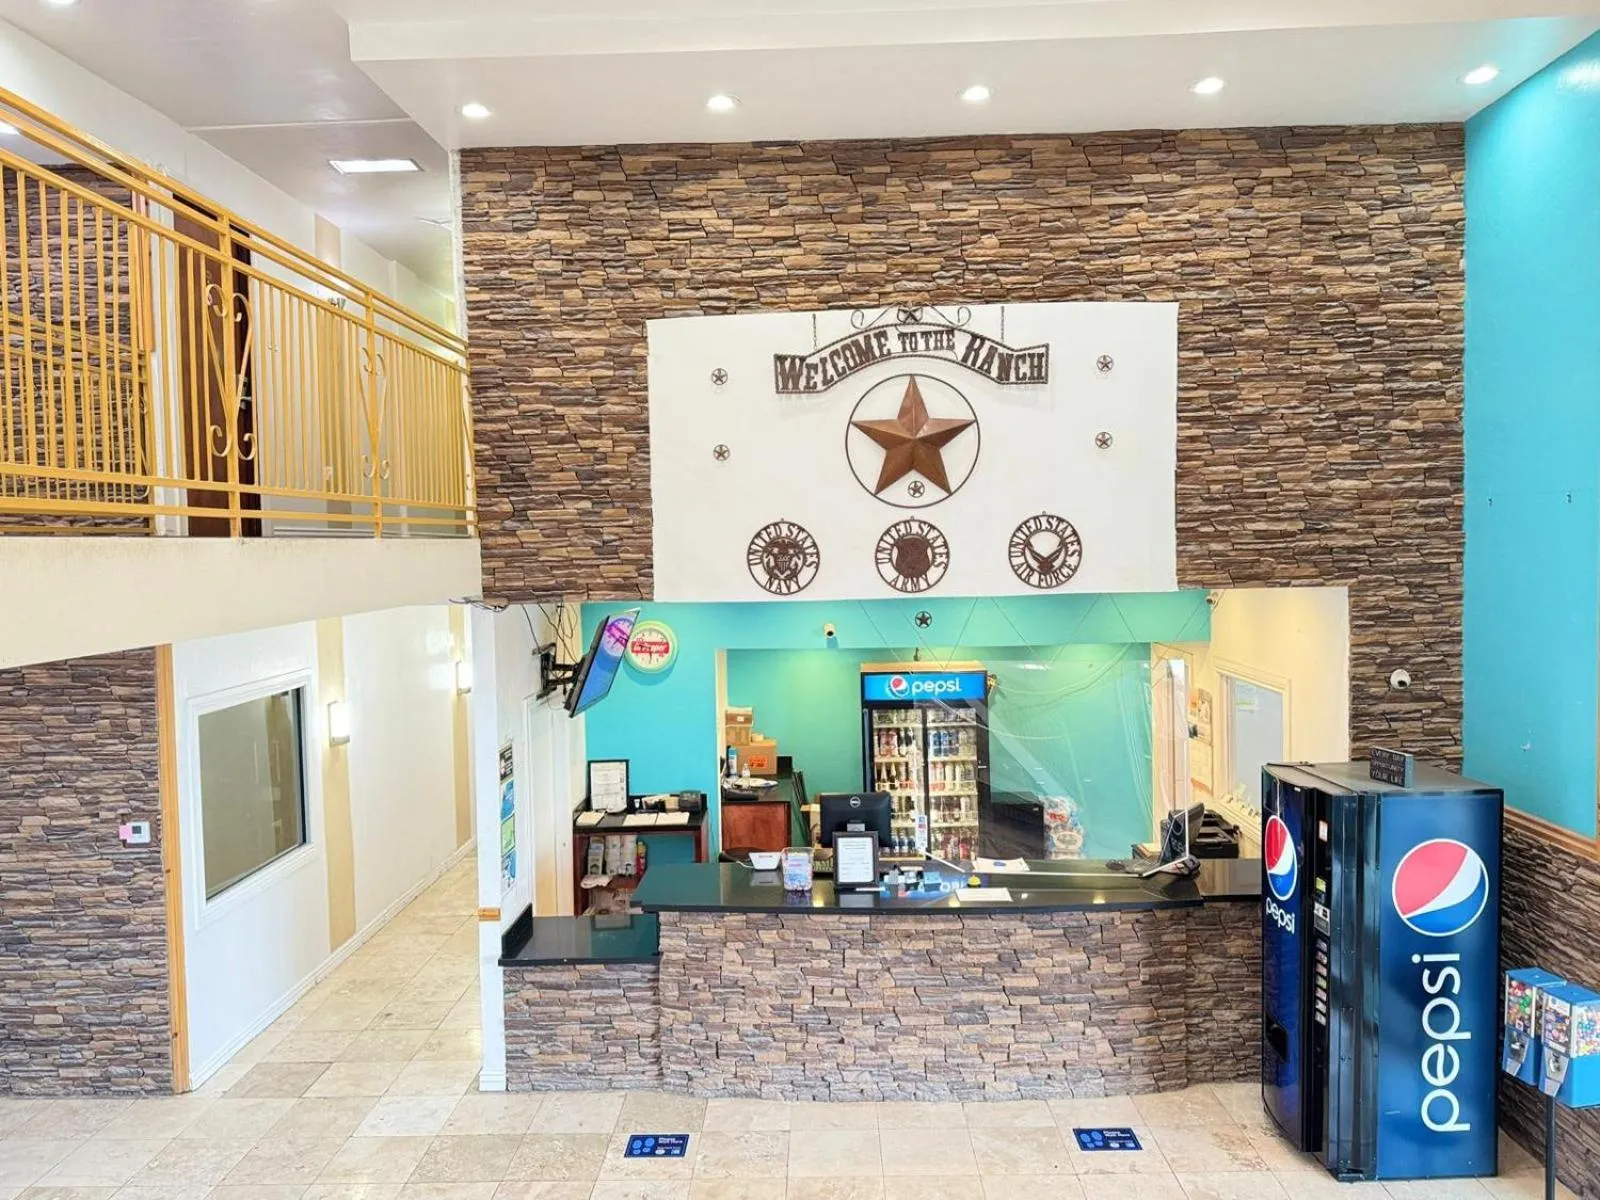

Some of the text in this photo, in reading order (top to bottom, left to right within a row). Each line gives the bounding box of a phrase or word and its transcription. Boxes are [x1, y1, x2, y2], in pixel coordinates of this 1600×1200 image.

[775, 329, 1046, 391] WELCOME TO THE RANCH
[748, 522, 819, 569] UNITED STATES
[876, 520, 949, 569] UNITED STATES
[1009, 515, 1081, 558] UNITED STATES
[763, 574, 801, 593] NAVY
[888, 573, 931, 592] ARMY
[1012, 562, 1077, 588] AIR FORCE
[911, 676, 962, 697] pepsi
[1266, 897, 1295, 934] pepsi
[1411, 953, 1472, 1132] pepsi
